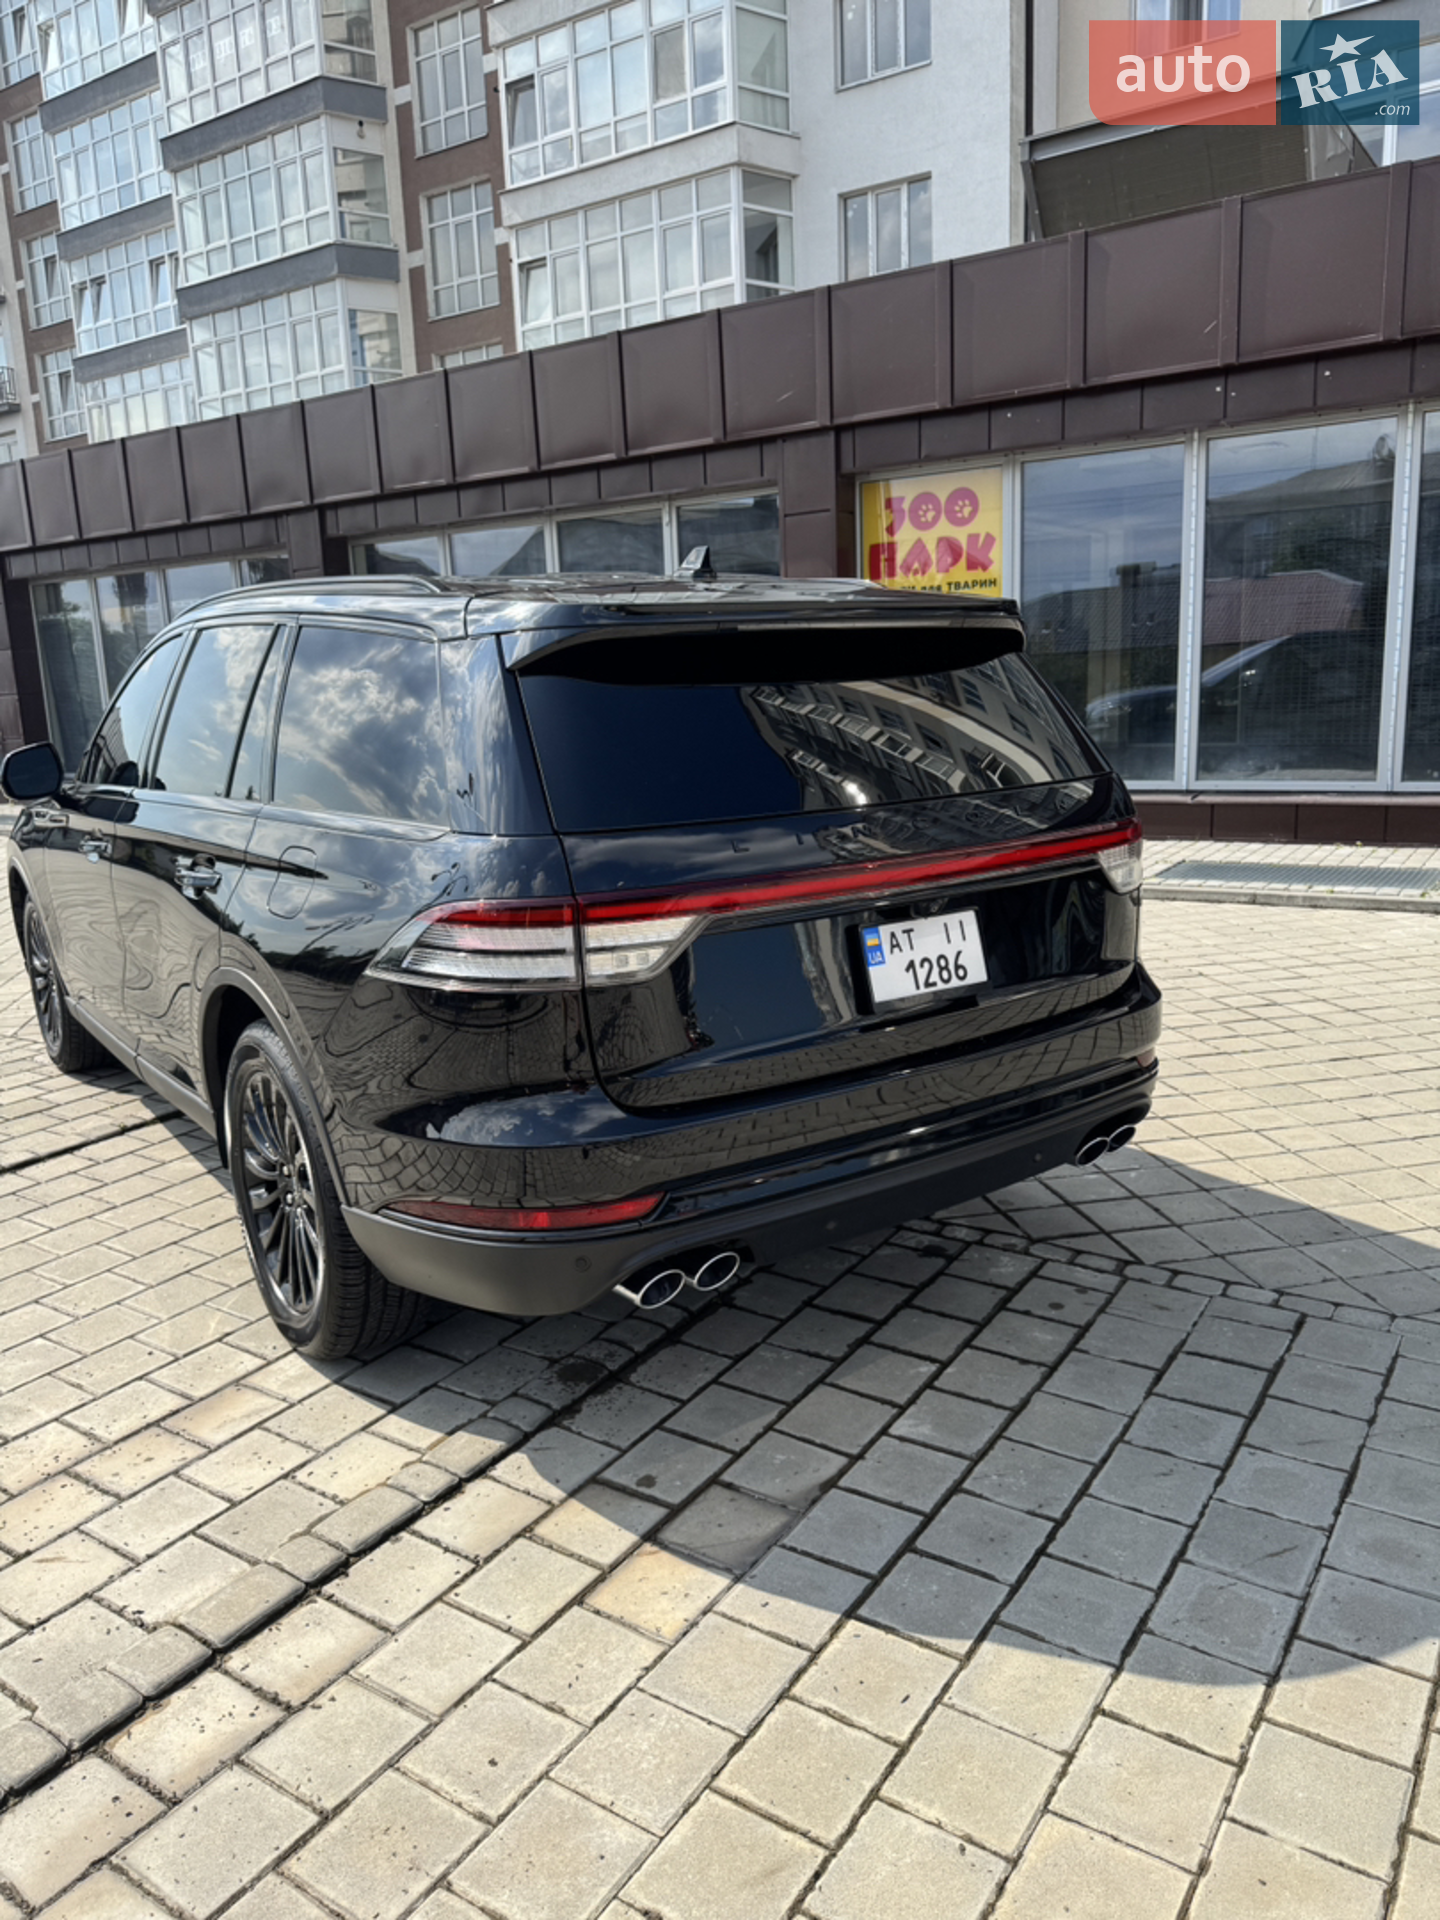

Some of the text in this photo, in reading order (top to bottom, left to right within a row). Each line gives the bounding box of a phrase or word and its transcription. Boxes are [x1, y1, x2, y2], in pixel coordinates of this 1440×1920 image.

[885, 486, 980, 537] ЗОО
[868, 532, 997, 581] ПАРК
[946, 577, 997, 591] ТВАРИН
[869, 951, 884, 965] UA
[890, 928, 915, 955] AT
[905, 950, 968, 991] 1286
